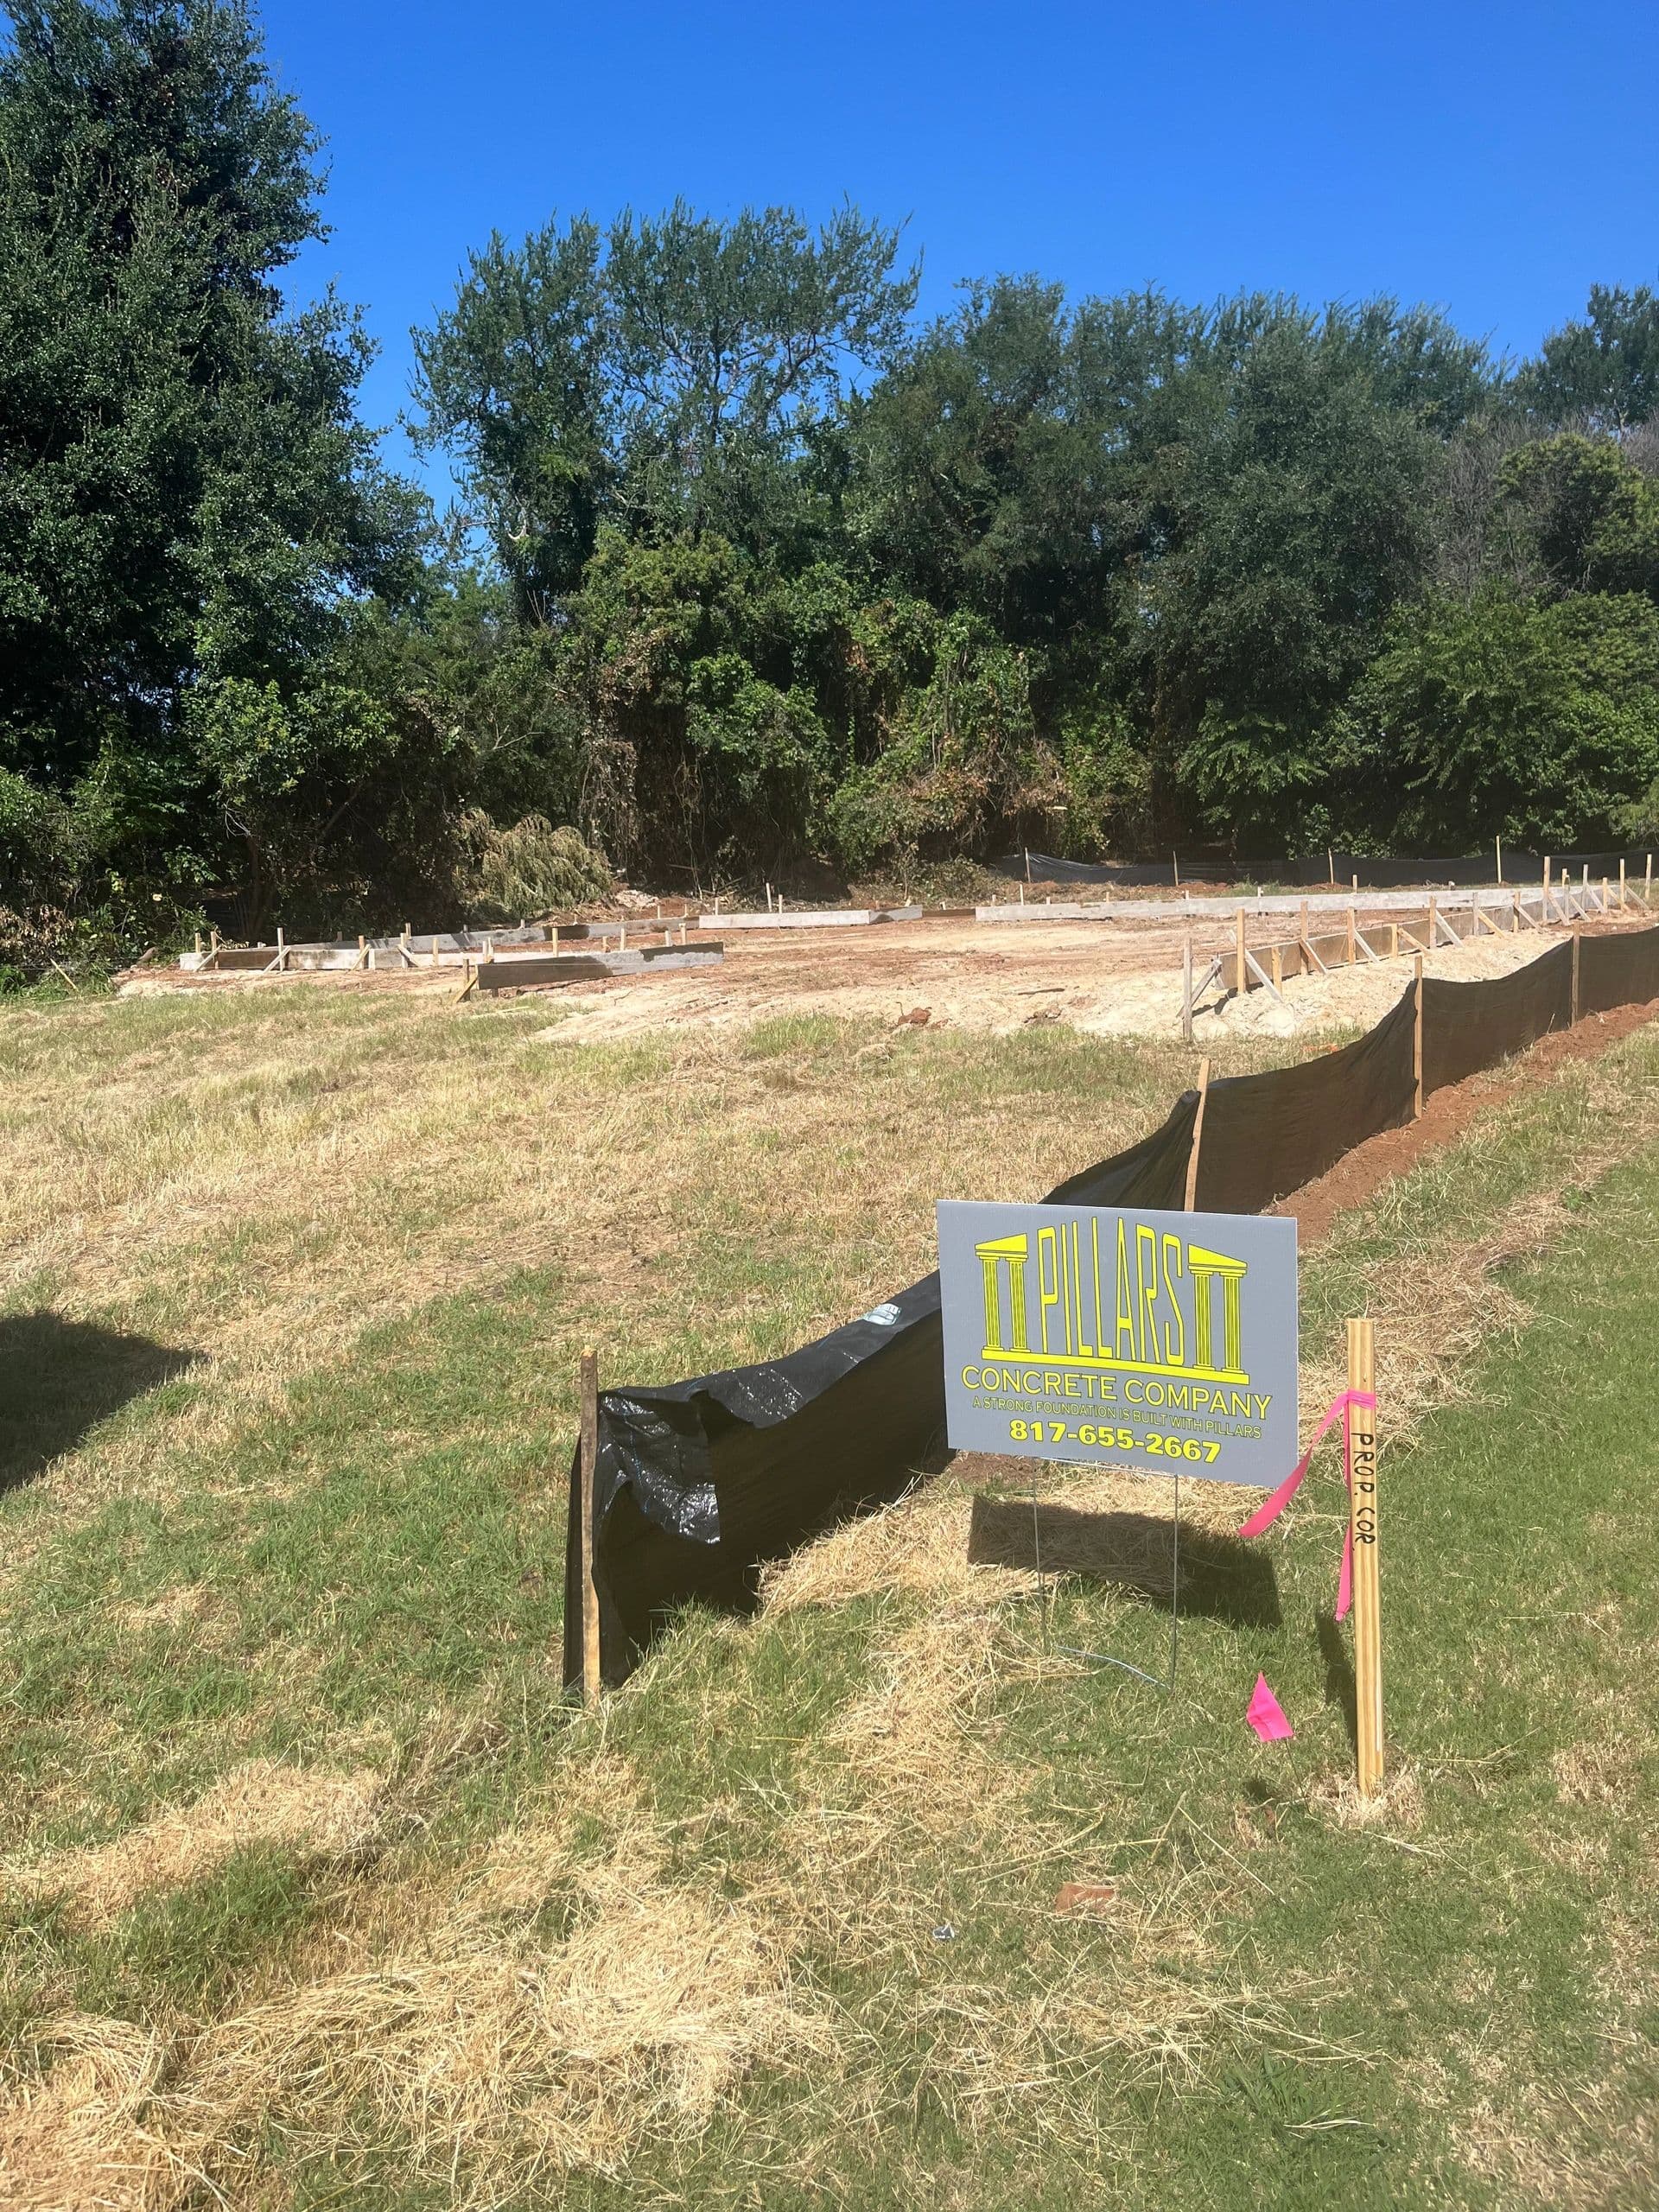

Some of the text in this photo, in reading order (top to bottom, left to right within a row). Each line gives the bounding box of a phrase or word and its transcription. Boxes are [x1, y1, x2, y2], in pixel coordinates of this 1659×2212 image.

[1037, 1216, 1185, 1367] PILLARS
[961, 1364, 1273, 1421] CONCRETE COMPANY
[972, 1395, 1262, 1439] A STRONG FOUNDATION IS BUILT WITH PILLARS
[1009, 1419, 1221, 1463] 817-655-2667
